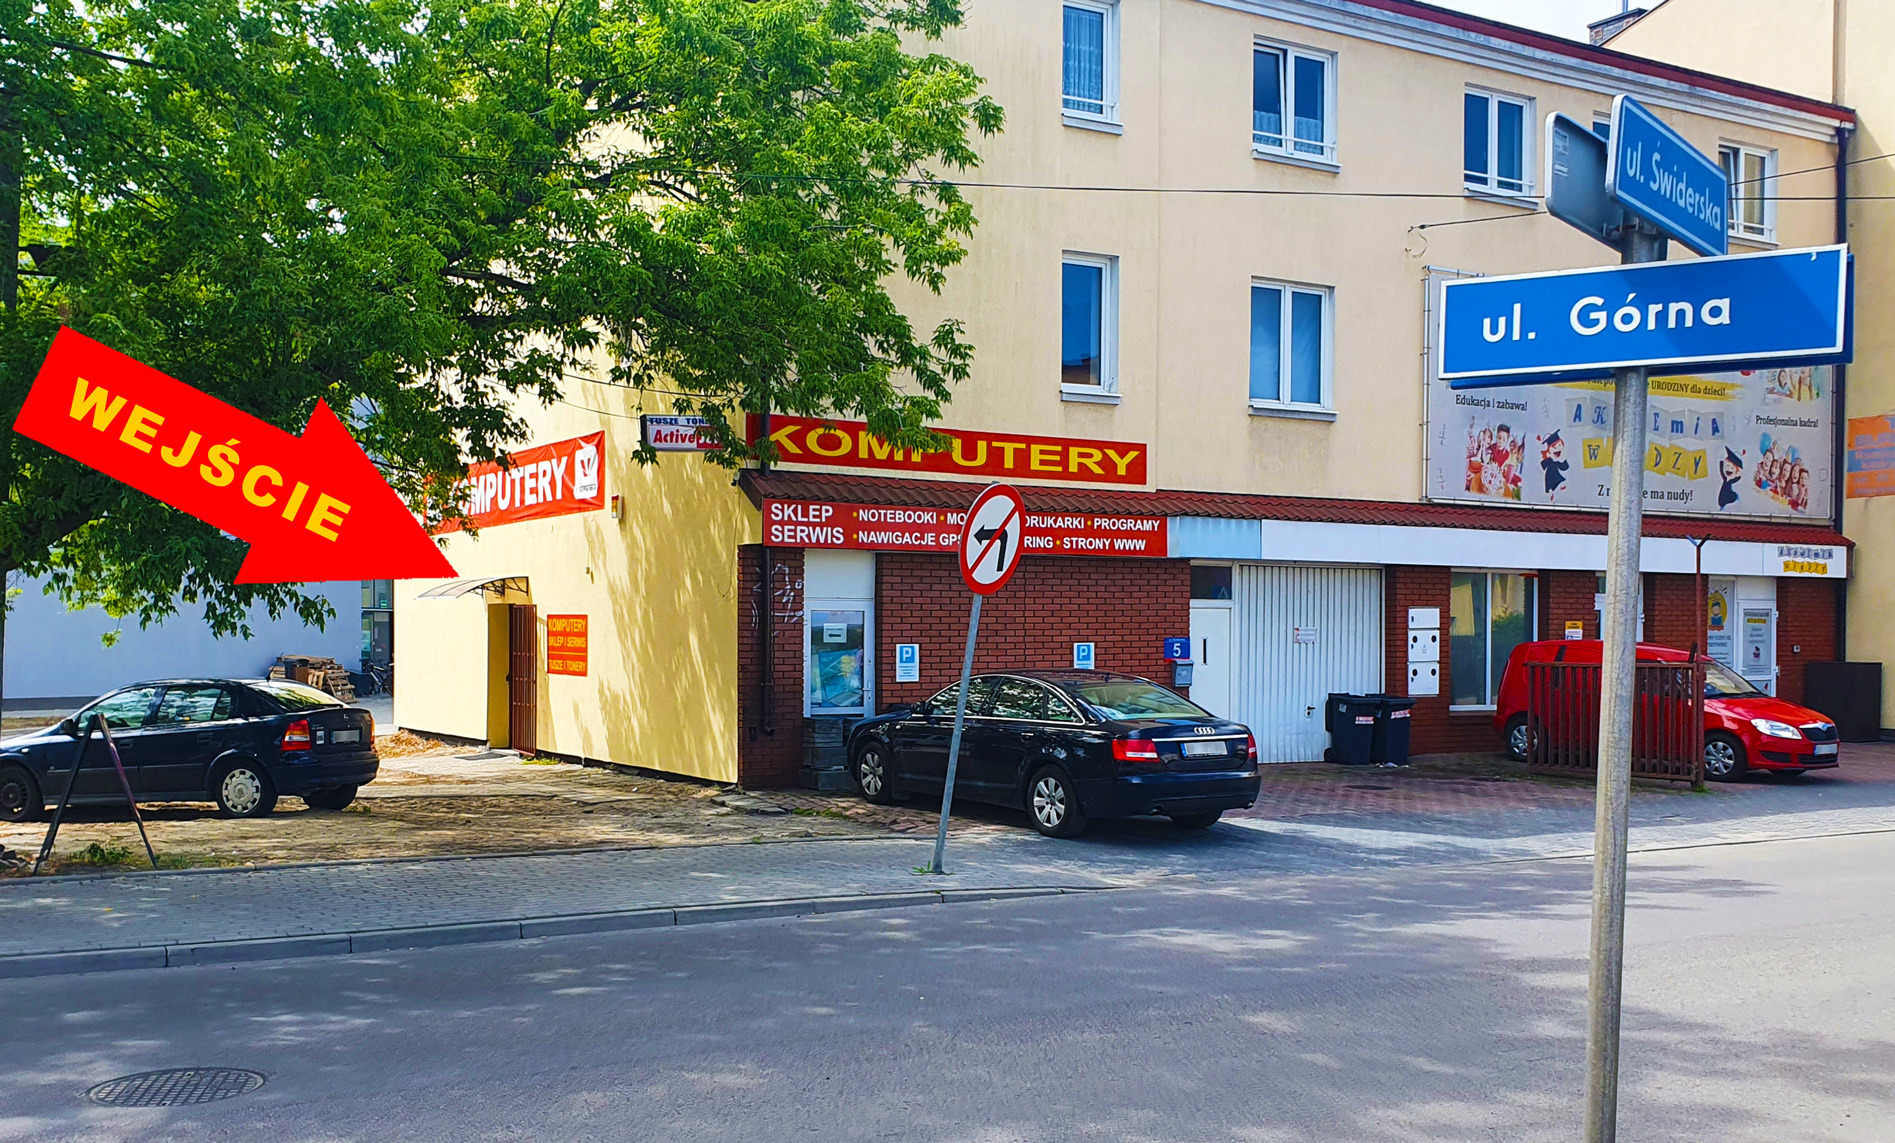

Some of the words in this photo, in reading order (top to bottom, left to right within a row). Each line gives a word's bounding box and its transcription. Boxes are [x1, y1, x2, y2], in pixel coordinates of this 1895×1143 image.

[1626, 141, 1644, 183] ul.
[1650, 140, 1721, 232] Świderska
[1483, 303, 1536, 343] ul.
[1570, 293, 1731, 336] Górna
[1651, 380, 1690, 393] URODZINY
[1690, 384, 1702, 394] dla
[1702, 386, 1726, 397] dzieci!
[1455, 394, 1491, 410] Edukacja
[1496, 399, 1528, 412] zabawa!
[649, 417, 679, 425] TUSZE
[1755, 414, 1798, 428] Profesjonalna
[1798, 417, 1819, 428] kadra!
[449, 456, 568, 516] OMPUTERY
[1597, 484, 1605, 497] Z
[1650, 489, 1665, 500] ma
[1666, 488, 1693, 504] nudy!
[770, 503, 834, 523] SKLEP
[858, 509, 937, 525] NOTEBOOKI
[1093, 518, 1160, 531] PROGRAMY
[770, 525, 845, 545] SERWIS
[858, 531, 936, 546] NAWIGACJE
[1024, 536, 1054, 549] RING
[1062, 537, 1114, 550] STRONY
[1113, 539, 1146, 551] WWW
[548, 618, 586, 632] KOMPUTERY
[548, 636, 563, 647] SKLEP
[567, 637, 586, 648] SERWIS
[1173, 643, 1181, 657] 5
[903, 647, 912, 662] P
[1080, 646, 1088, 659] P
[548, 659, 563, 670] TUSZE
